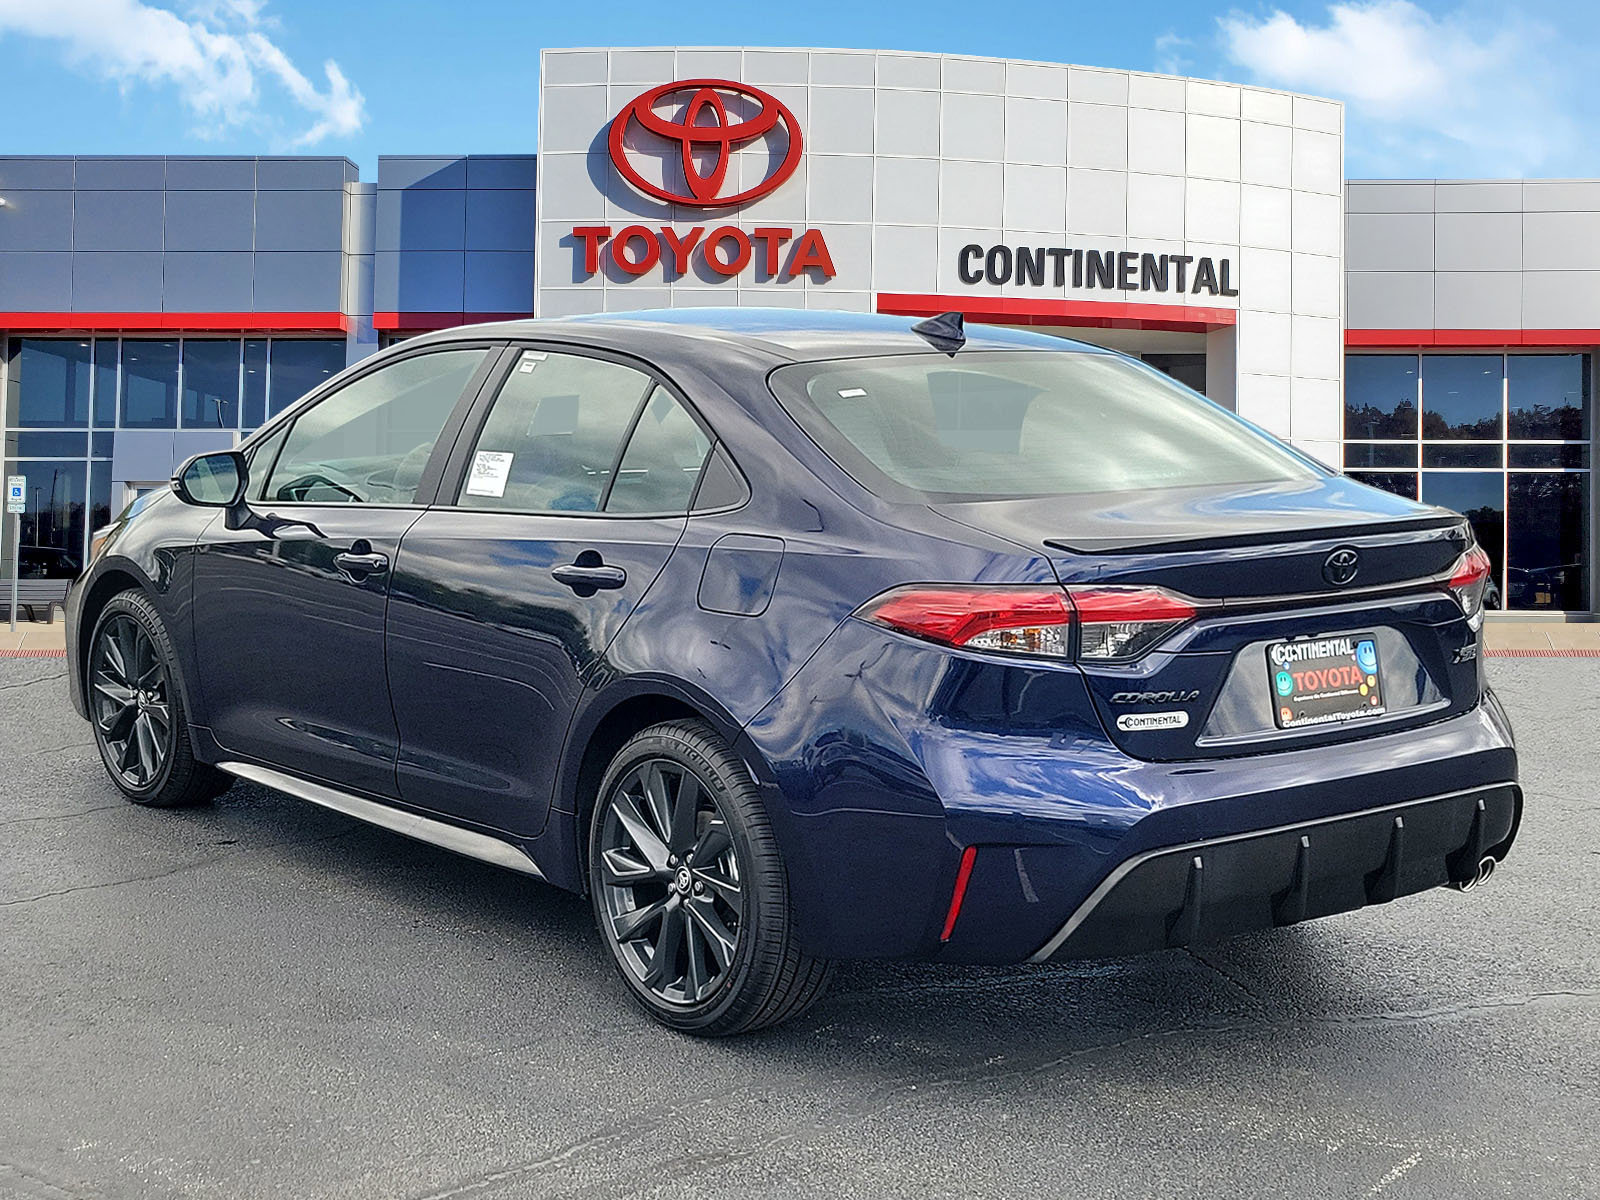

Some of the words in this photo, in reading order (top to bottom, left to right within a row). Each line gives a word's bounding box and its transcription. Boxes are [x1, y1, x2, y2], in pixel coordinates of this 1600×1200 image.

[573, 225, 836, 278] TOYOTA
[958, 243, 1239, 296] CONTINENTAL
[1270, 638, 1354, 665] CONTINENTAL
[1292, 665, 1364, 691] TOYOTA
[1110, 690, 1200, 704] COROLLA
[1125, 715, 1182, 728] CONTINENTAL
